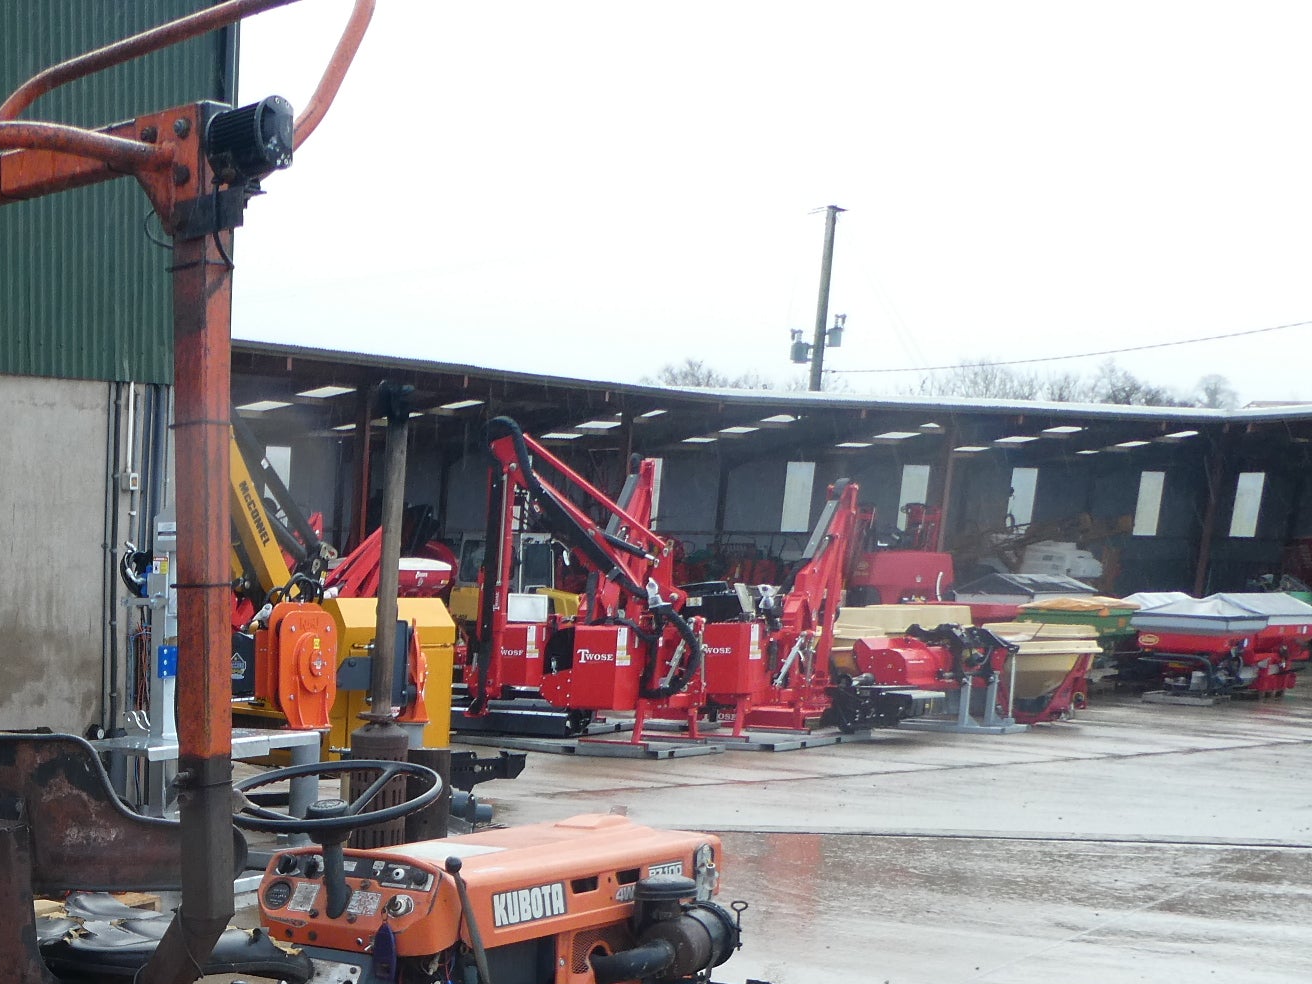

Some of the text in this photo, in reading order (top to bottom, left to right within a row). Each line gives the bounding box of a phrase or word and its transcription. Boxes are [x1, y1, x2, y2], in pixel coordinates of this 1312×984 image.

[577, 648, 614, 664] TWOSE
[702, 643, 732, 655] WOSE
[493, 882, 565, 927] KUBOTA
